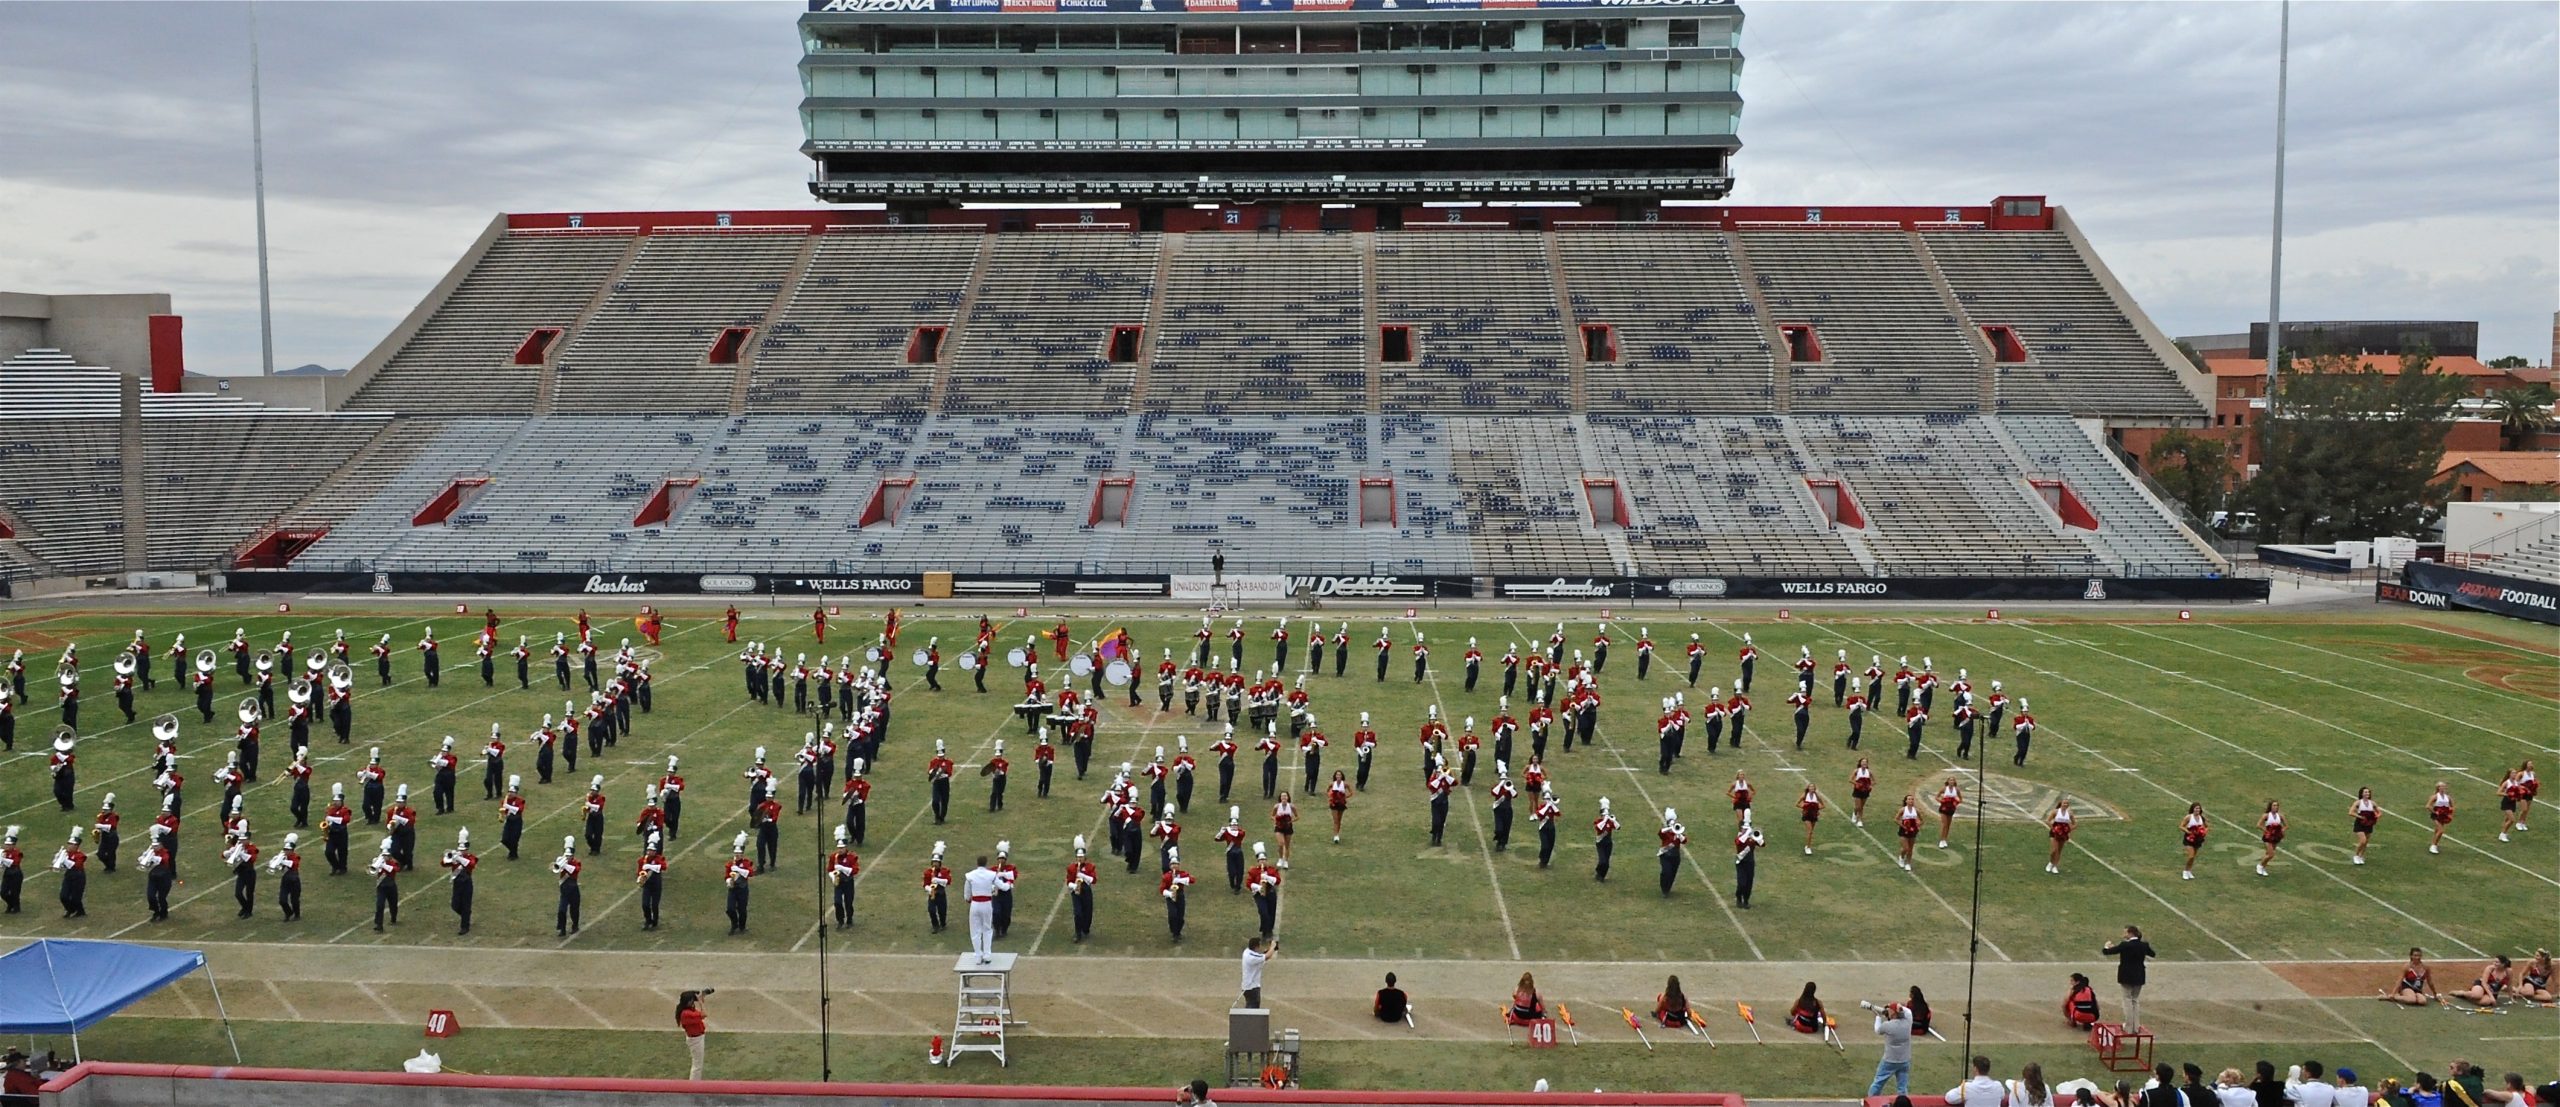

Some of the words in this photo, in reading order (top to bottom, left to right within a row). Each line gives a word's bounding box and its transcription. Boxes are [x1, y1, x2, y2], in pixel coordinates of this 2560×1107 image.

[821, 0, 936, 11] ARIZONA
[570, 219, 581, 228] 17
[718, 217, 730, 227] 18
[1080, 215, 1093, 224] 20
[1227, 214, 1238, 224] 21
[1807, 213, 1820, 223] 24
[1946, 214, 1959, 222] 25
[219, 381, 229, 390] 16
[584, 574, 648, 592] Bashas'
[808, 579, 860, 590] WELLS
[862, 579, 912, 590] FARGO
[1249, 581, 1268, 592] BAND
[1269, 581, 1281, 592] DAY
[1781, 583, 1834, 594] WELLS
[1836, 583, 1888, 594] FARGO
[2381, 585, 2410, 601] BEAR
[2409, 590, 2446, 607] DOWN
[2500, 588, 2557, 610] FOOTBALL
[428, 1013, 447, 1034] 40
[1533, 1023, 1552, 1043] 40
